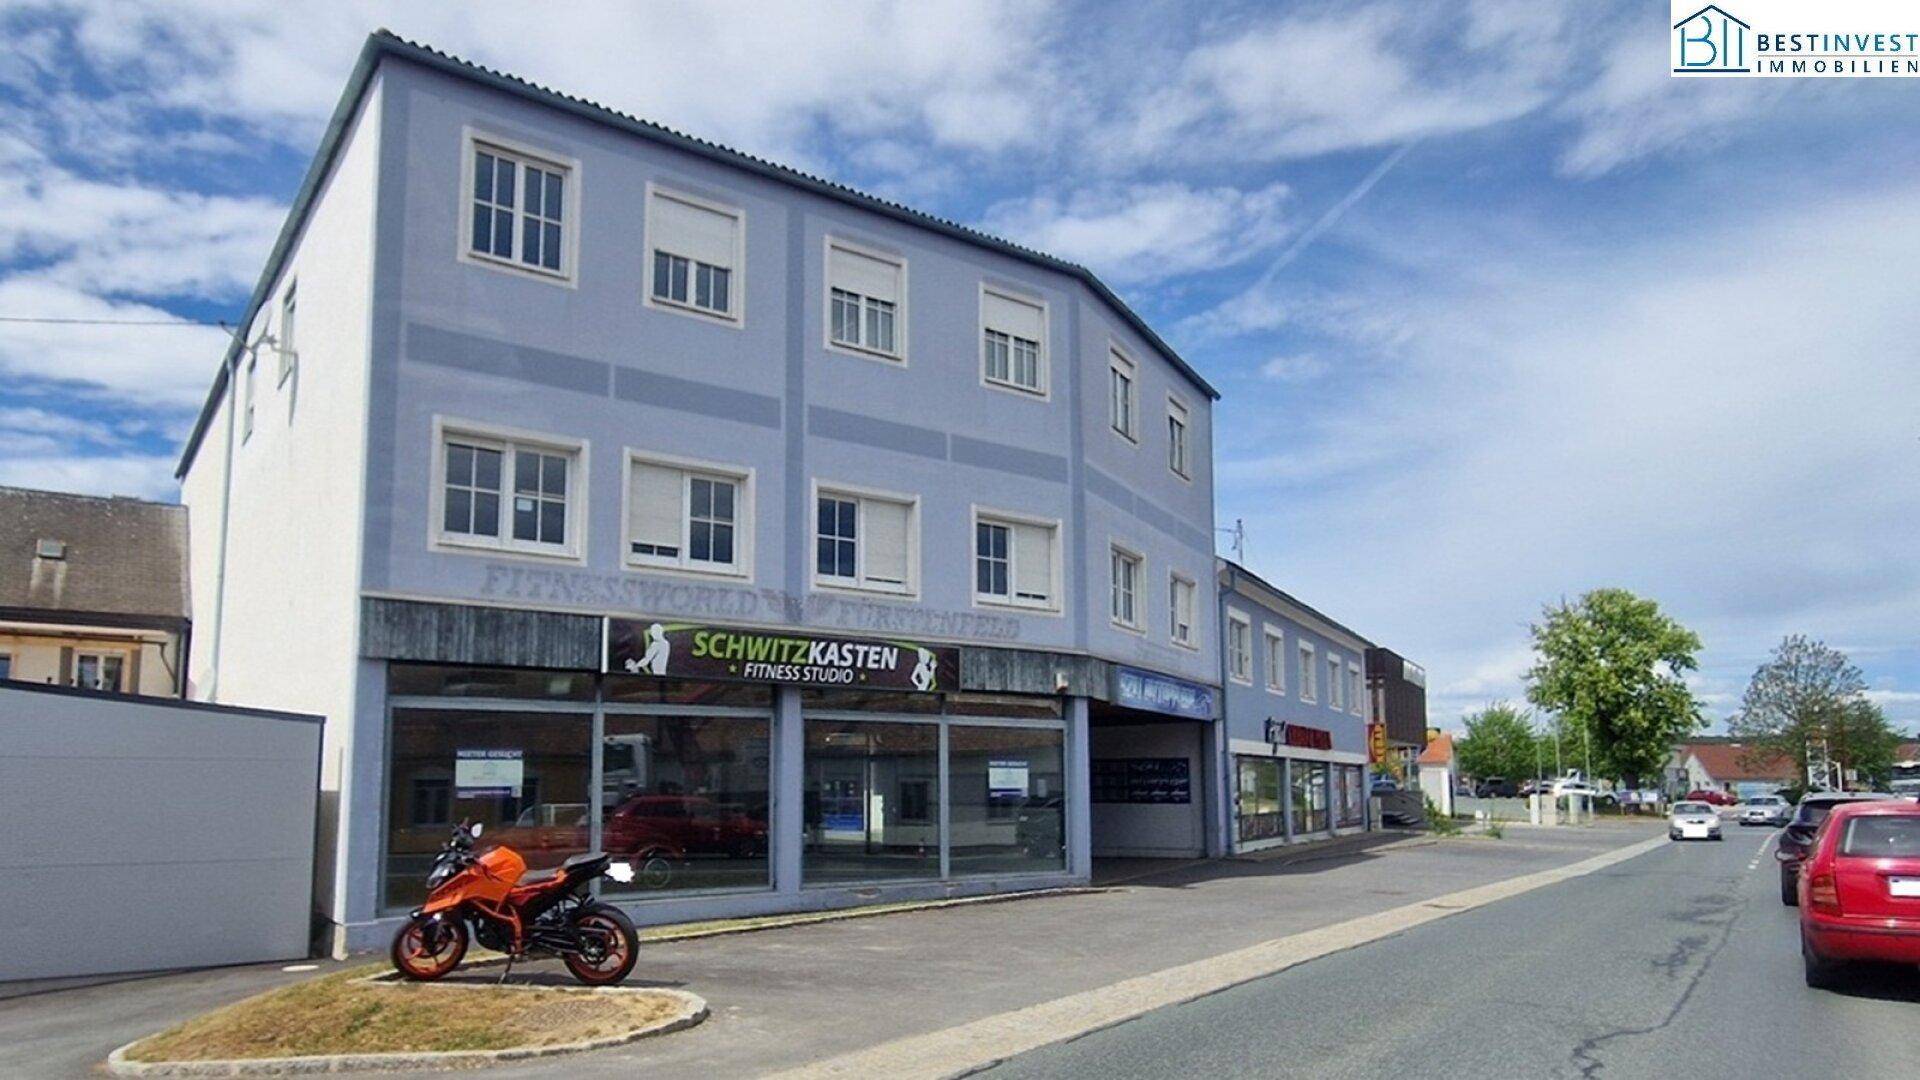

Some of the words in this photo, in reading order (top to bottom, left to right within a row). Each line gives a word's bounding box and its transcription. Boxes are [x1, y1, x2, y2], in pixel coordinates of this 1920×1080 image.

[691, 630, 899, 671] SCHWITZKASTEN
[743, 662, 800, 681] FITNESS
[802, 665, 854, 684] STUDIO
